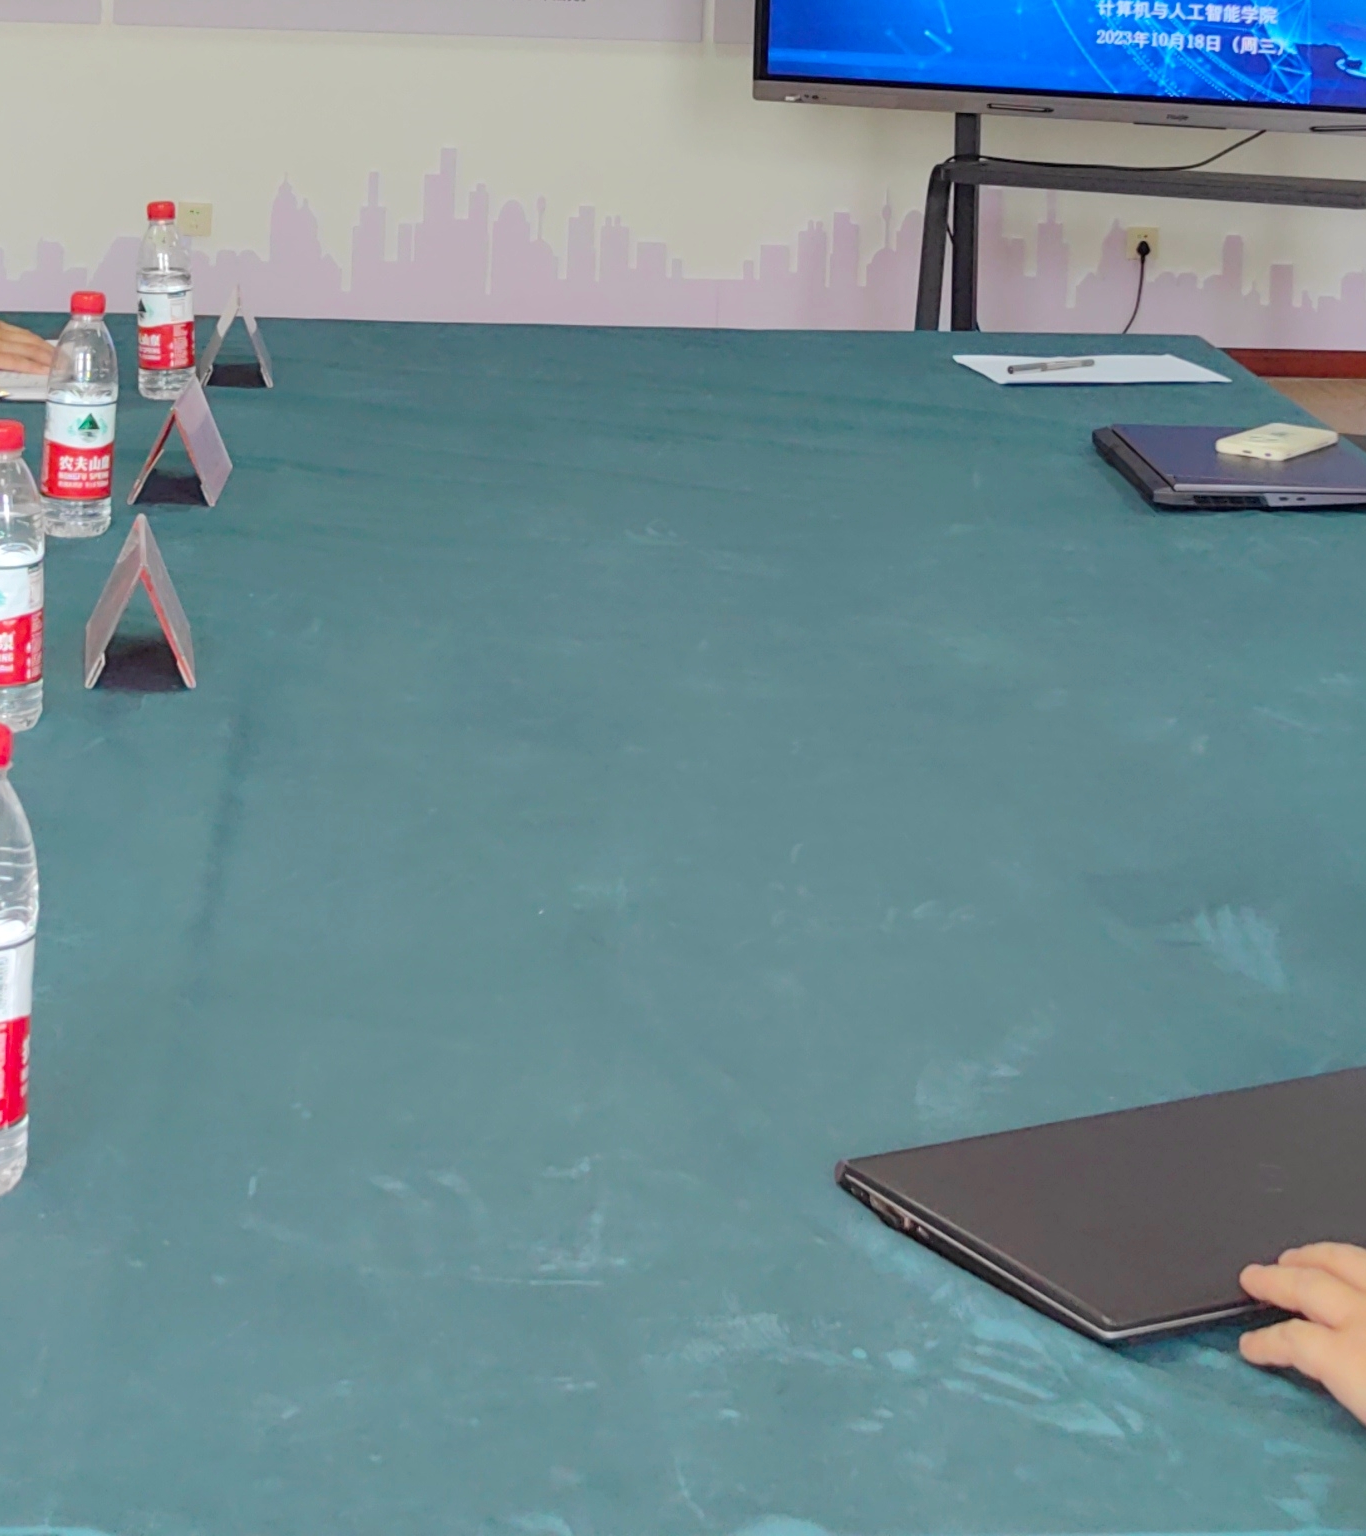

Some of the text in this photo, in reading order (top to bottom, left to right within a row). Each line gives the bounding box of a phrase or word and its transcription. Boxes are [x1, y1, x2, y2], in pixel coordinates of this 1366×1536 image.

[1096, 0, 1278, 24] 计算机与人工智能学院
